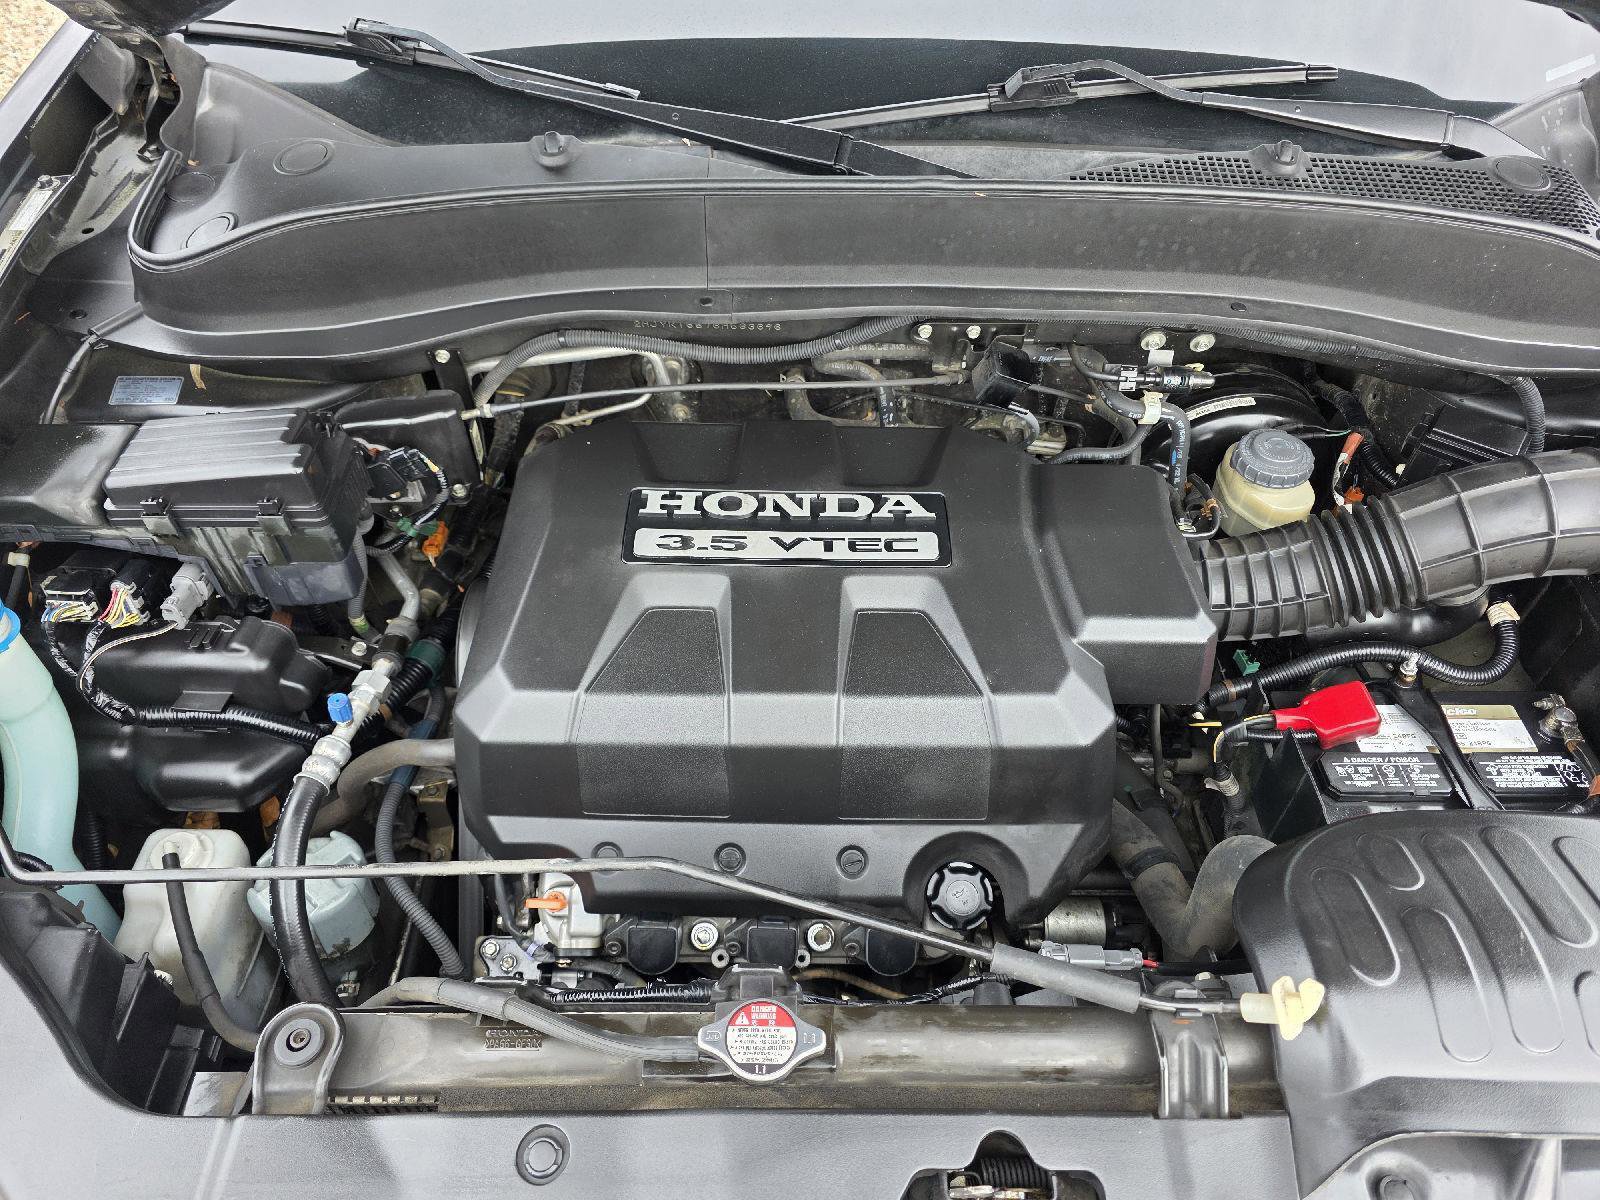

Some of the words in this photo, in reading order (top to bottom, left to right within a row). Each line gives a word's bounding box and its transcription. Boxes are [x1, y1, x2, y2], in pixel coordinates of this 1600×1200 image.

[638, 489, 937, 520] HONDA
[655, 533, 748, 551] 3.5
[768, 536, 919, 553] VTEC
